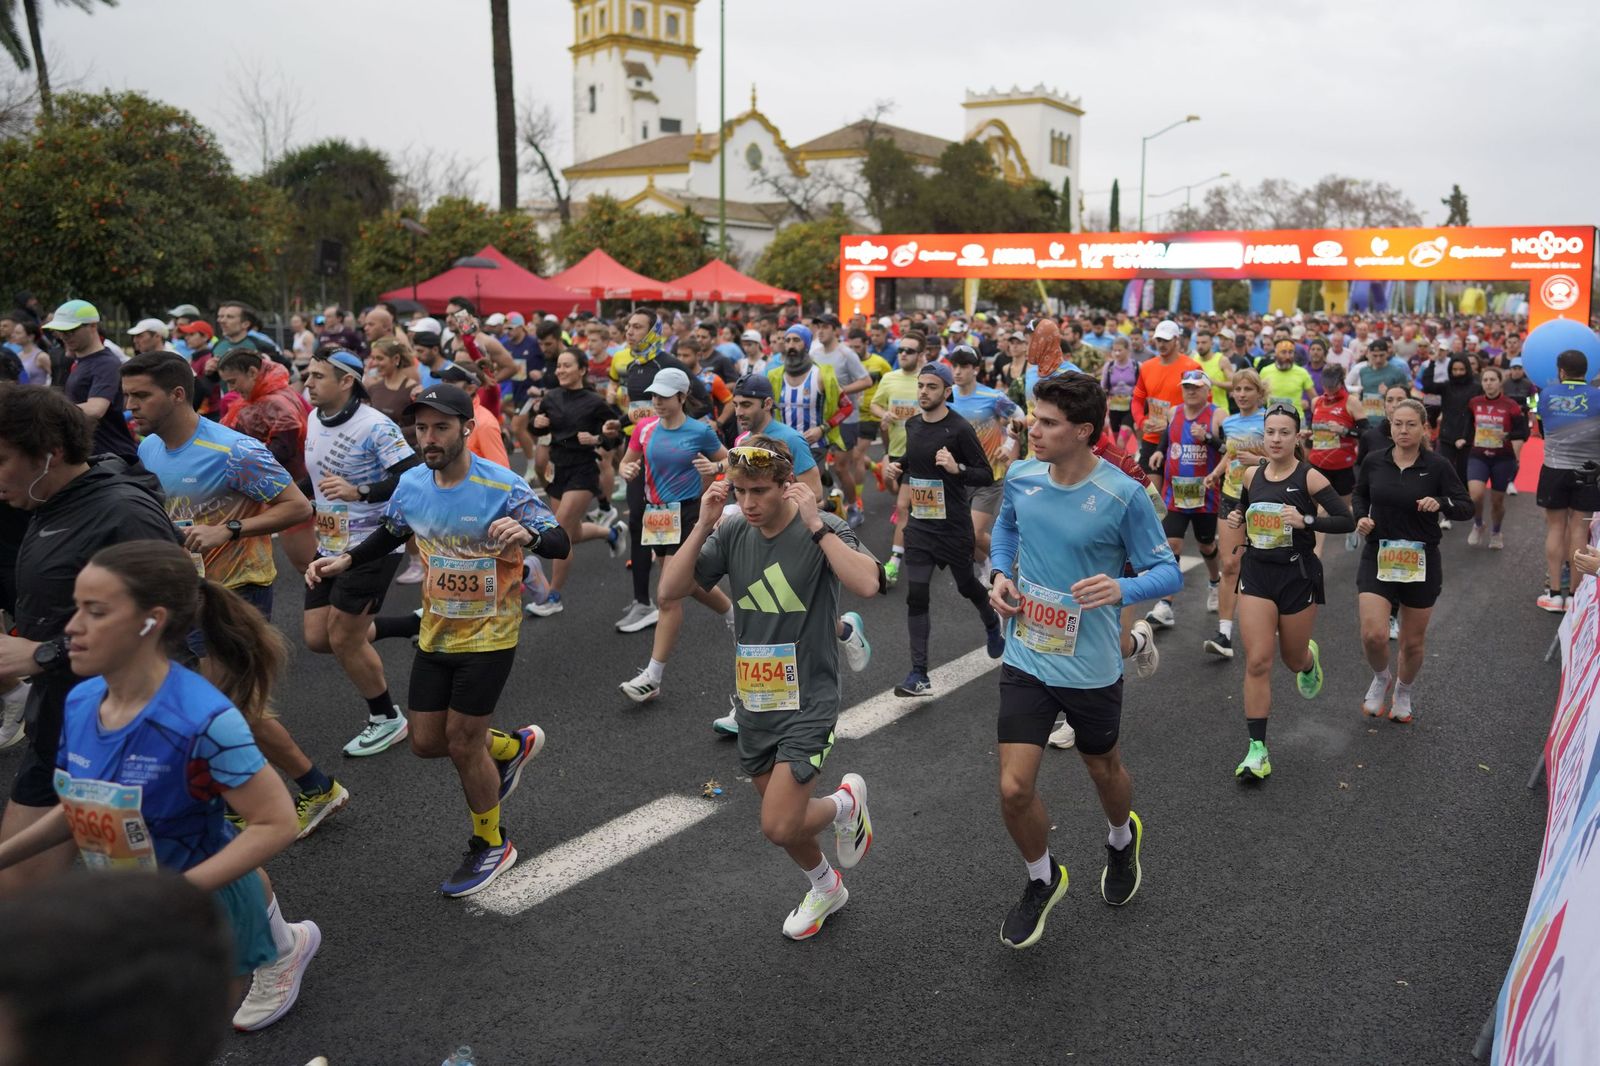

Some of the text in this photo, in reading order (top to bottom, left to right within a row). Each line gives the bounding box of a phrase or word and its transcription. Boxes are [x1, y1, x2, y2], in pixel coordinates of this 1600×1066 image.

[1182, 444, 1208, 453] TERRA
[436, 572, 479, 592] 4533
[1019, 594, 1067, 629] 21098
[738, 661, 785, 682] 17454
